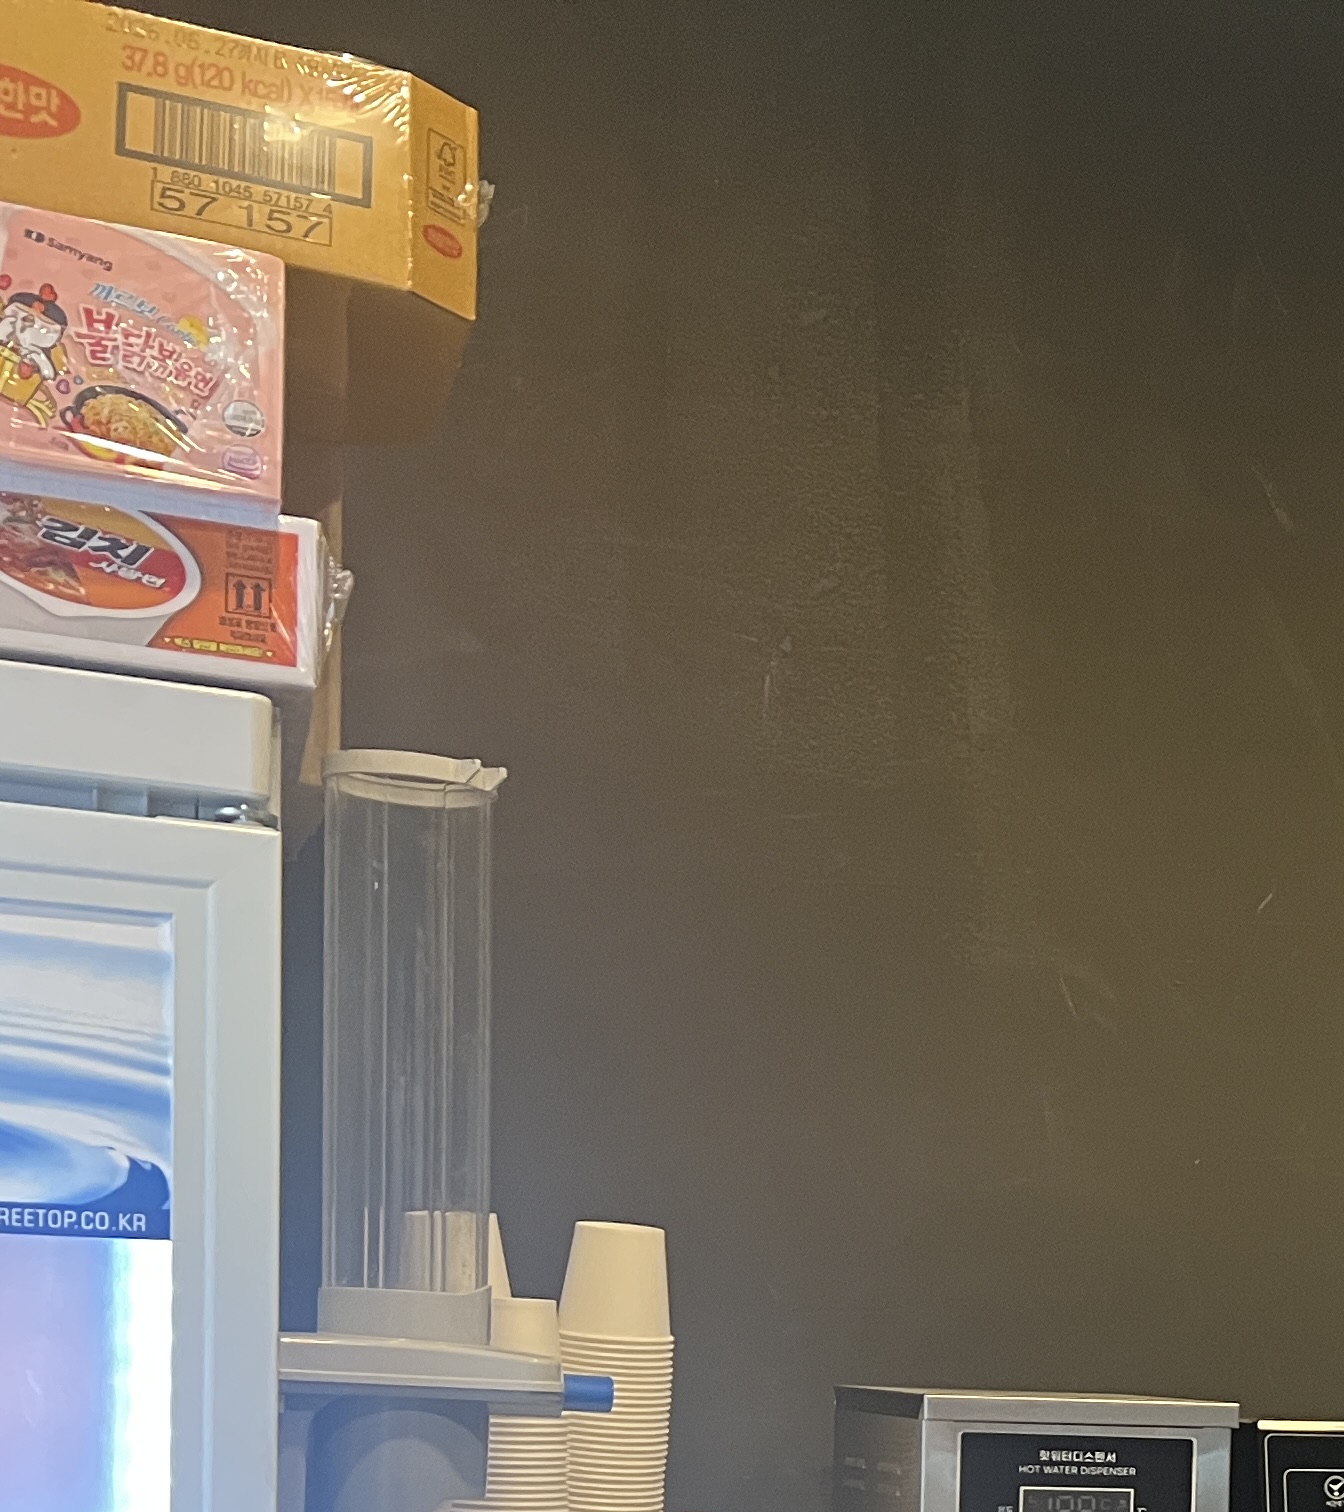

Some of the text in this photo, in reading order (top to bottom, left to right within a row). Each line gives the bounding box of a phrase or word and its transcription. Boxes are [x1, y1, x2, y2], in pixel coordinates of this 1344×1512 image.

[157, 186, 324, 239] 57 157
[212, 179, 254, 200] 1045
[262, 190, 314, 212] 57157
[47, 237, 114, 272] Samyang
[1018, 1465, 1137, 1476] HOT WATER DISPENSER
